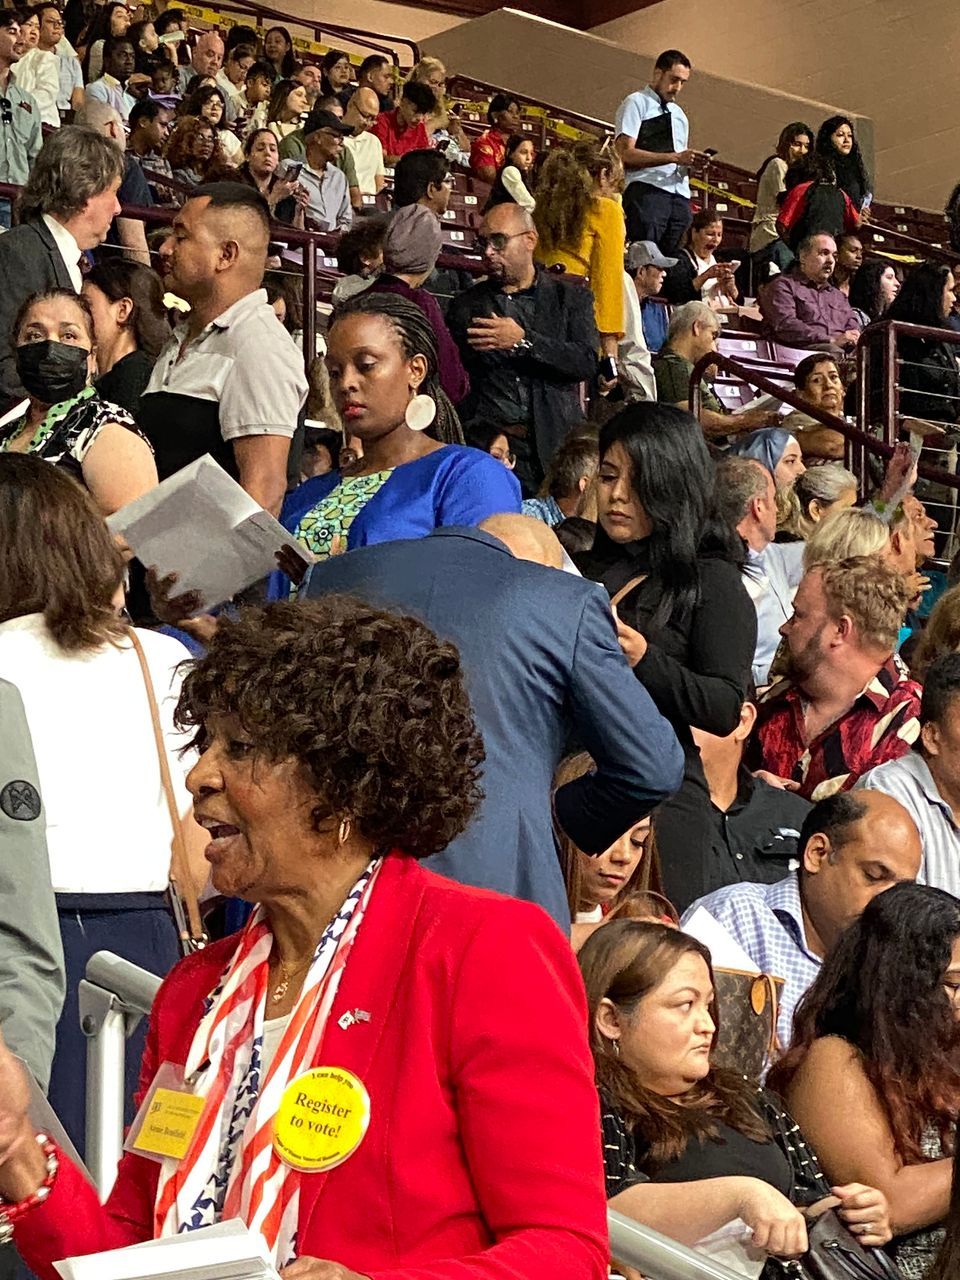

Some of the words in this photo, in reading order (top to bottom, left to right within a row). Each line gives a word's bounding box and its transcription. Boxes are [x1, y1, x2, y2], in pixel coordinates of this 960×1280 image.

[330, 1072, 343, 1083] help
[295, 1092, 351, 1118] Register
[290, 1115, 304, 1128] to
[308, 1121, 342, 1138] vote!
